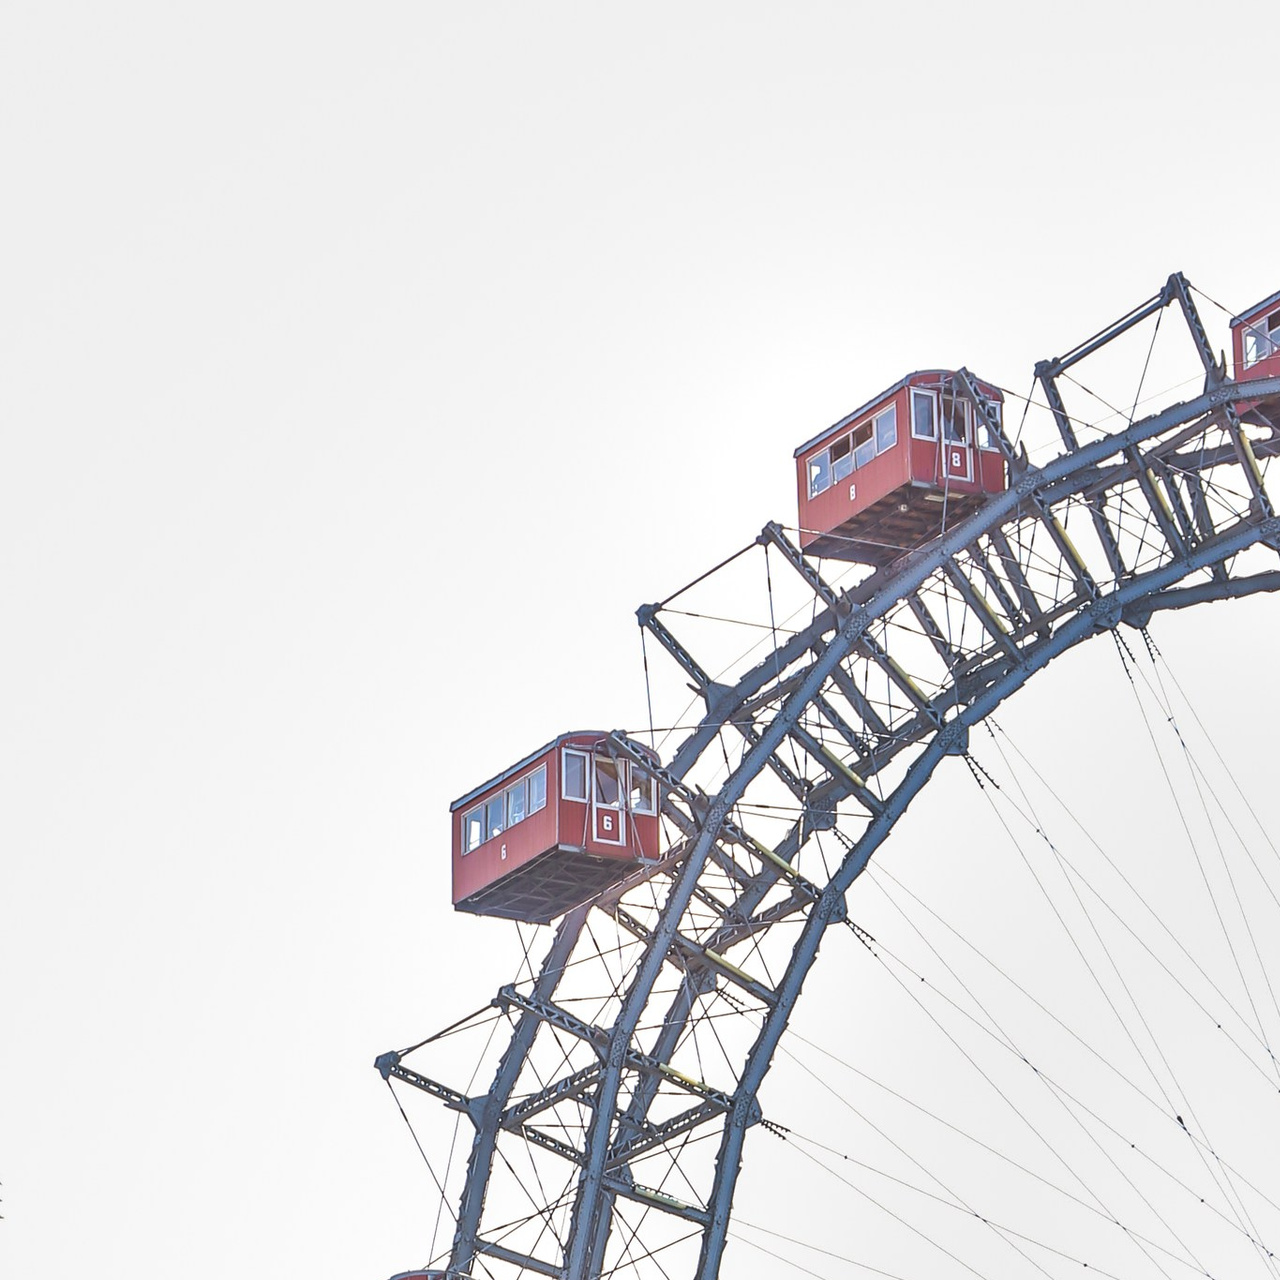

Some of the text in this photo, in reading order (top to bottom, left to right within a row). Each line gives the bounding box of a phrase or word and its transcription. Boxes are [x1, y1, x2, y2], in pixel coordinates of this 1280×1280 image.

[951, 452, 961, 467] 8
[849, 484, 856, 501] 8
[603, 815, 613, 831] 6
[501, 844, 507, 861] 6
